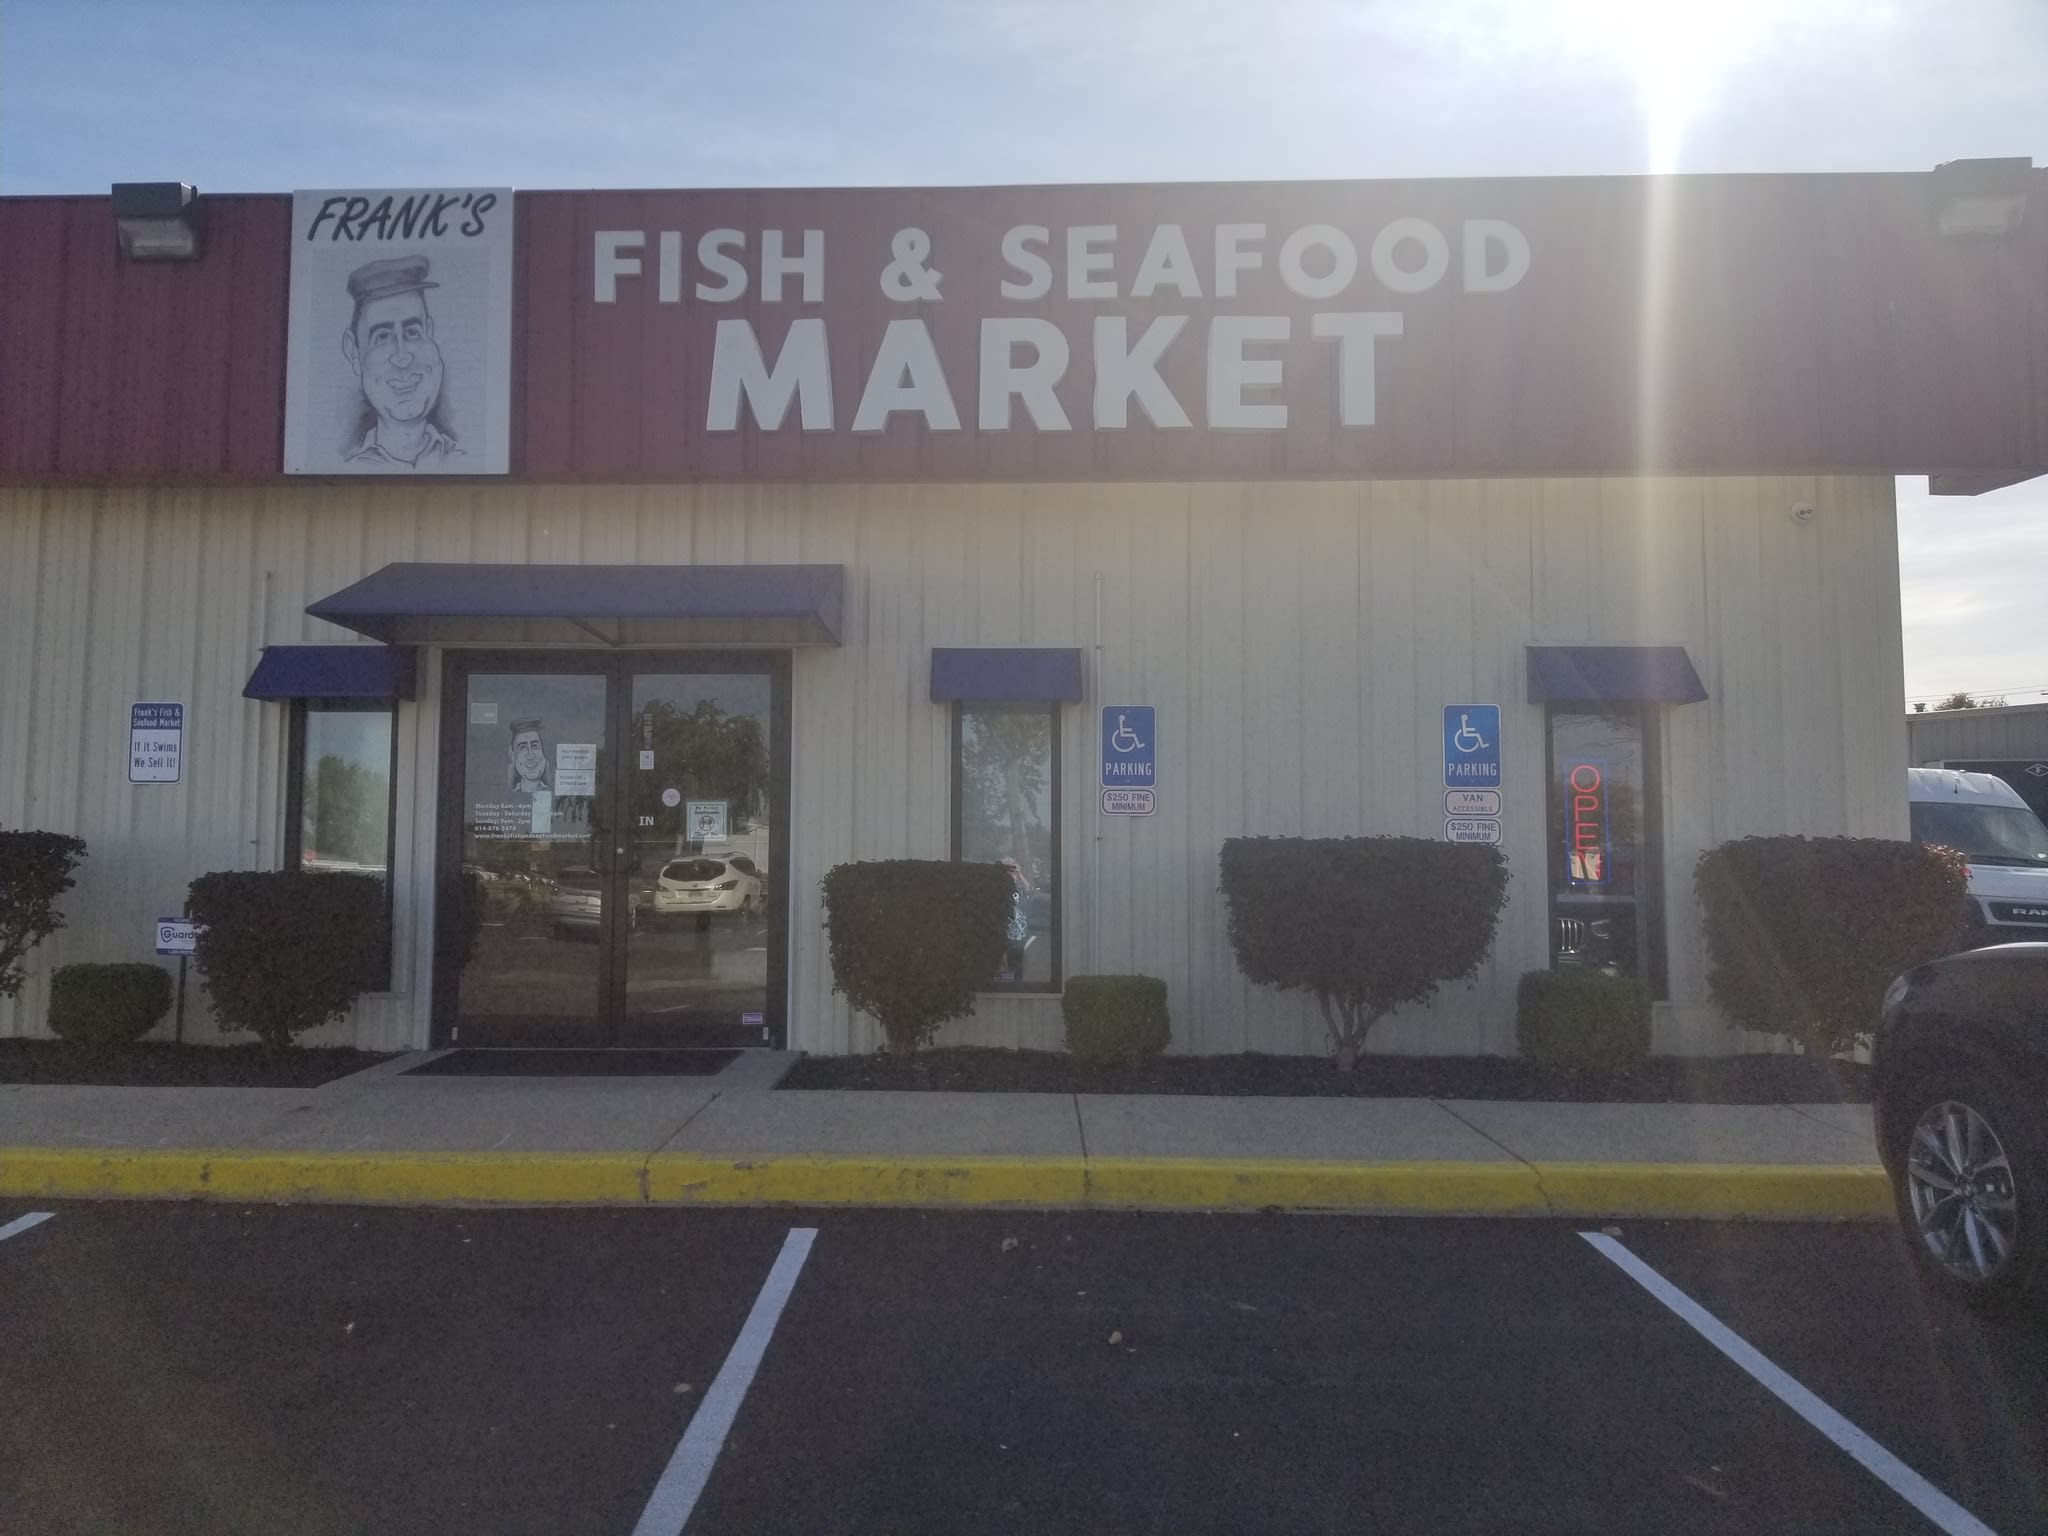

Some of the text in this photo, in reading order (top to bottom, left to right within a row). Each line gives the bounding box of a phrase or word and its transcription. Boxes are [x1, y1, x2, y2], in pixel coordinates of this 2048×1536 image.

[307, 193, 496, 241] FRANK'S
[594, 218, 1531, 303] FISH & SEAFOOD
[706, 312, 1404, 432] MARKET
[134, 707, 180, 717] Frank's Fish &
[133, 718, 180, 727] Seafood Market
[134, 741, 141, 752] If
[153, 741, 177, 752] Swims
[134, 757, 145, 768] We
[148, 757, 163, 768] Sell
[1105, 762, 1152, 776] PARKING
[1448, 762, 1497, 776] PARKING
[1106, 793, 1150, 802] $250 FINE
[1462, 793, 1484, 803] VAN
[1112, 802, 1146, 812] MINIMUM
[1453, 805, 1493, 813] ACCESSIBLE
[639, 816, 654, 826] IN
[1570, 764, 1601, 881] OPEN
[1450, 822, 1496, 832] $250 FINE
[1456, 832, 1491, 841] MINIMUM
